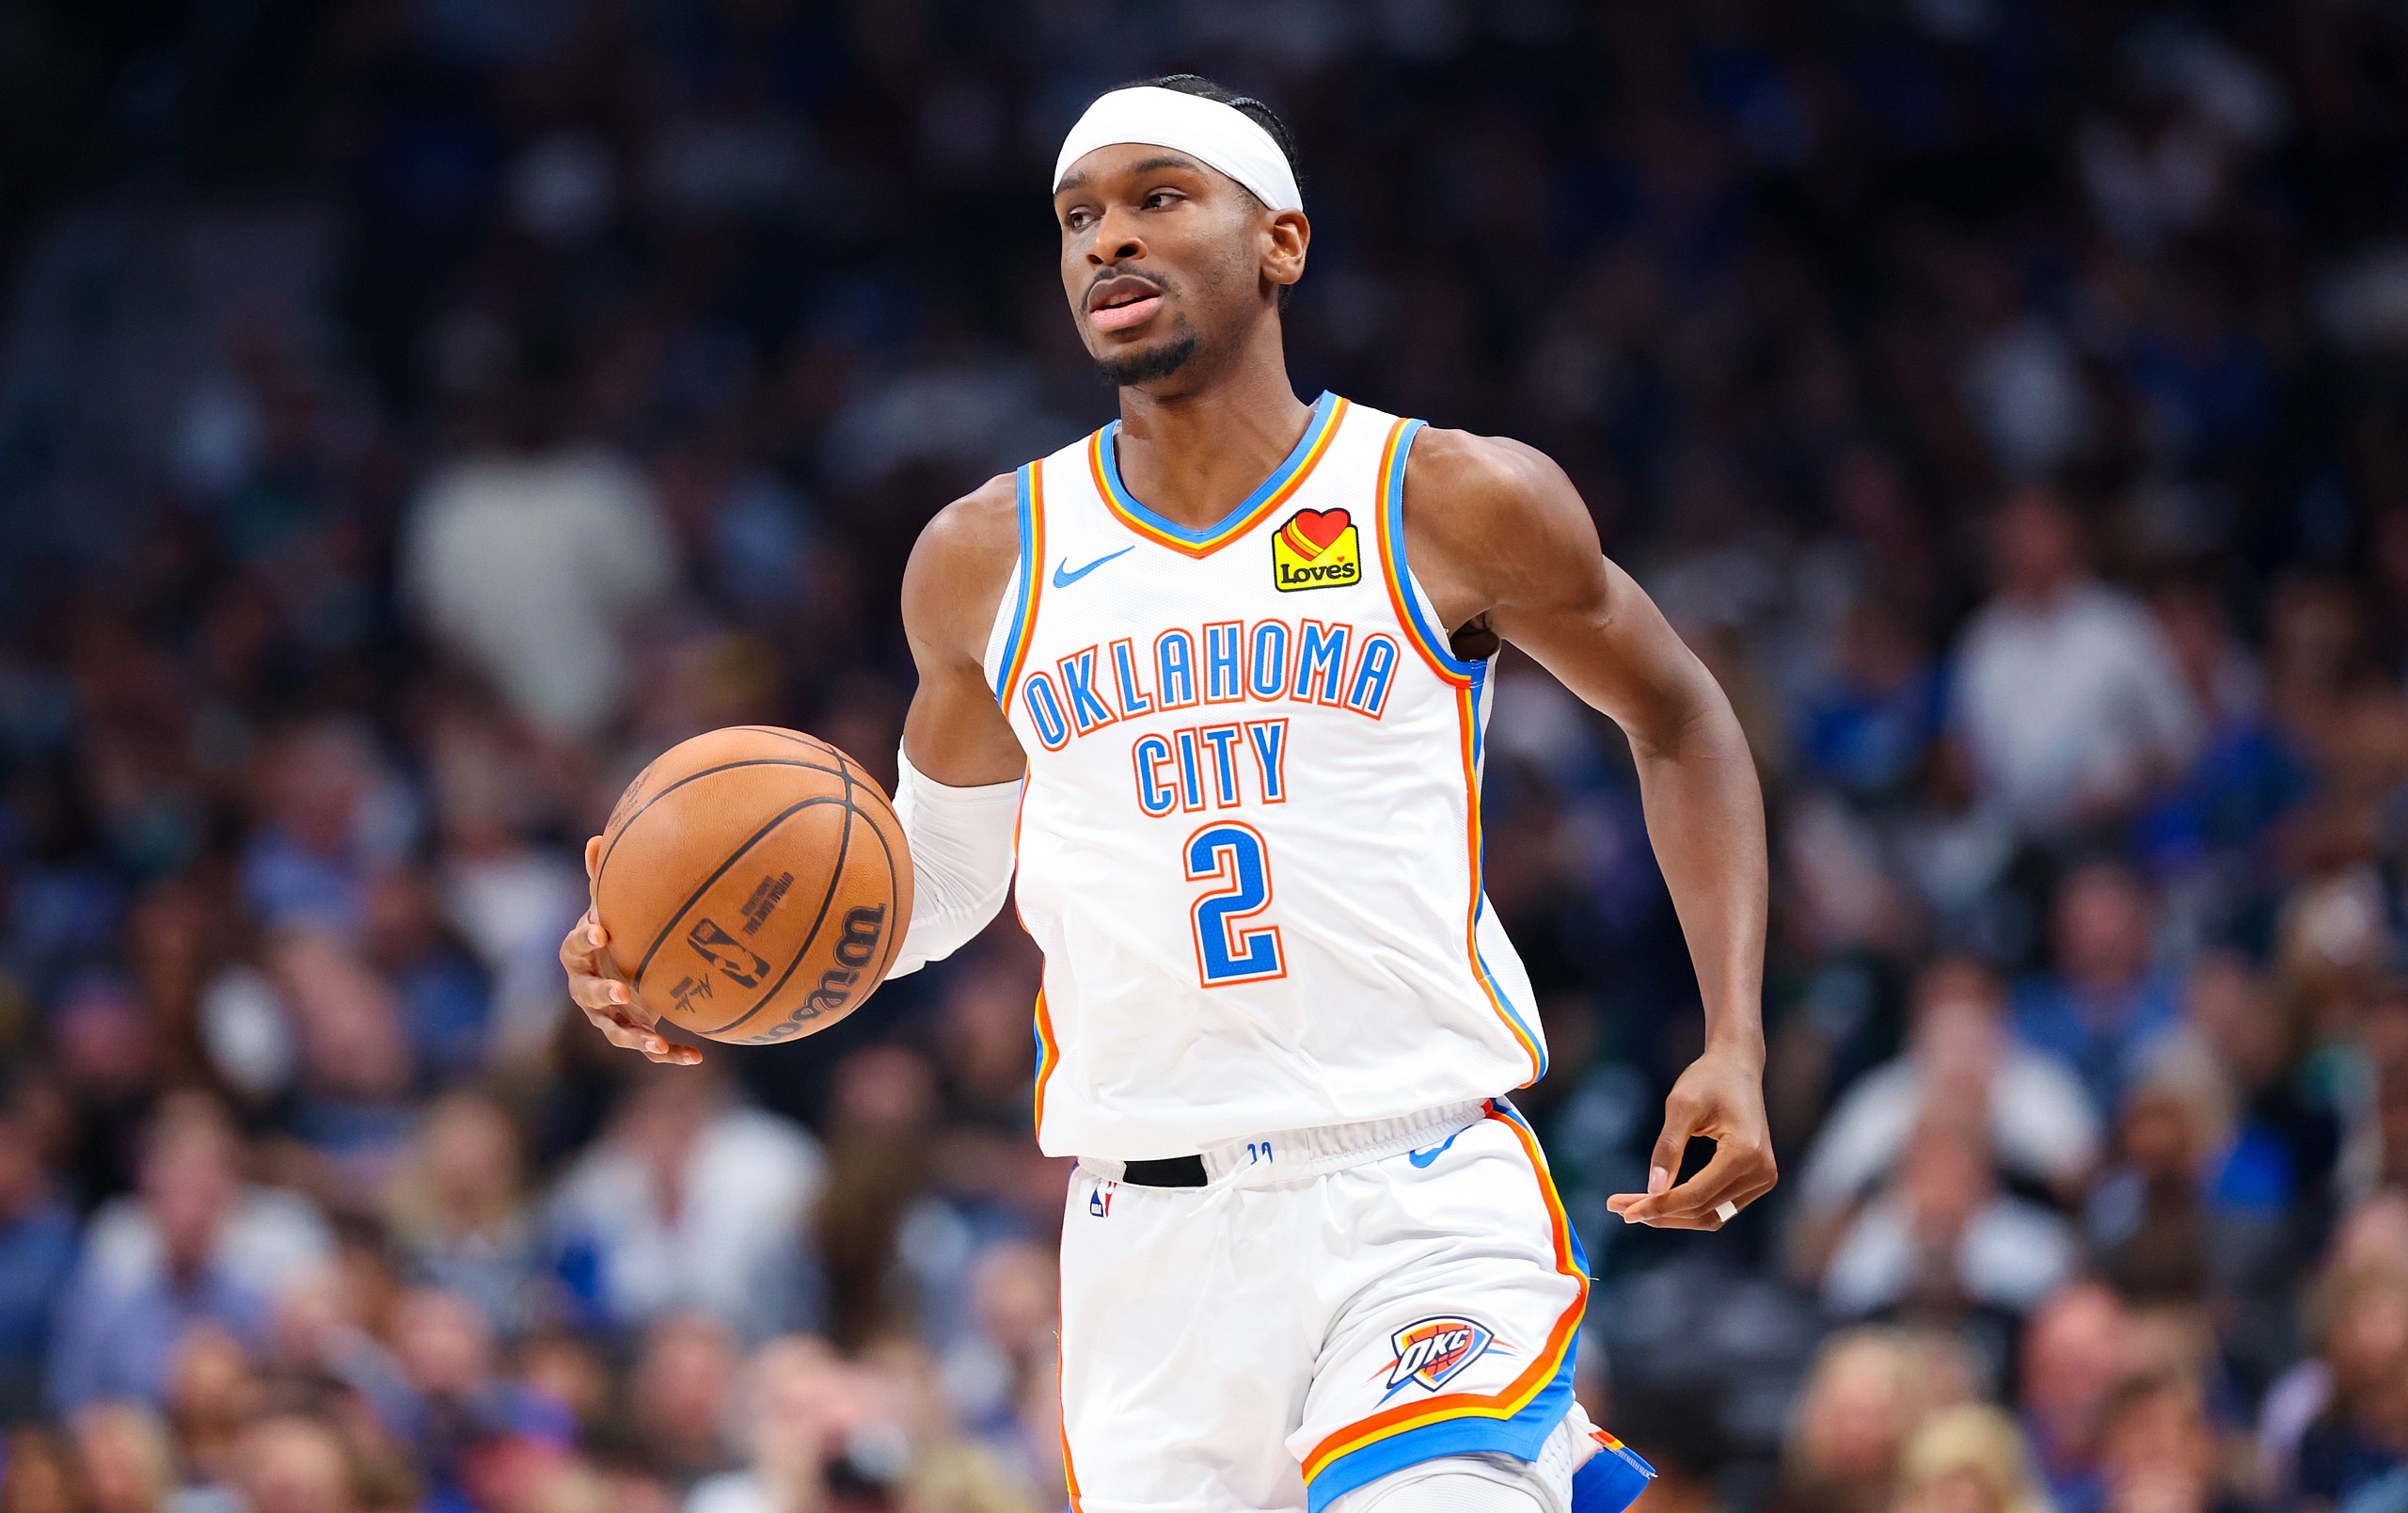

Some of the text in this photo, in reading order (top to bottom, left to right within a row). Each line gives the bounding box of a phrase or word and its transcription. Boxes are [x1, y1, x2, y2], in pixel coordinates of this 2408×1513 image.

[1022, 617, 1401, 752] OKLAHOMA
[1132, 717, 1290, 819] CITY
[1182, 820, 1288, 989] 2
[1386, 1328, 1472, 1390] OKC
